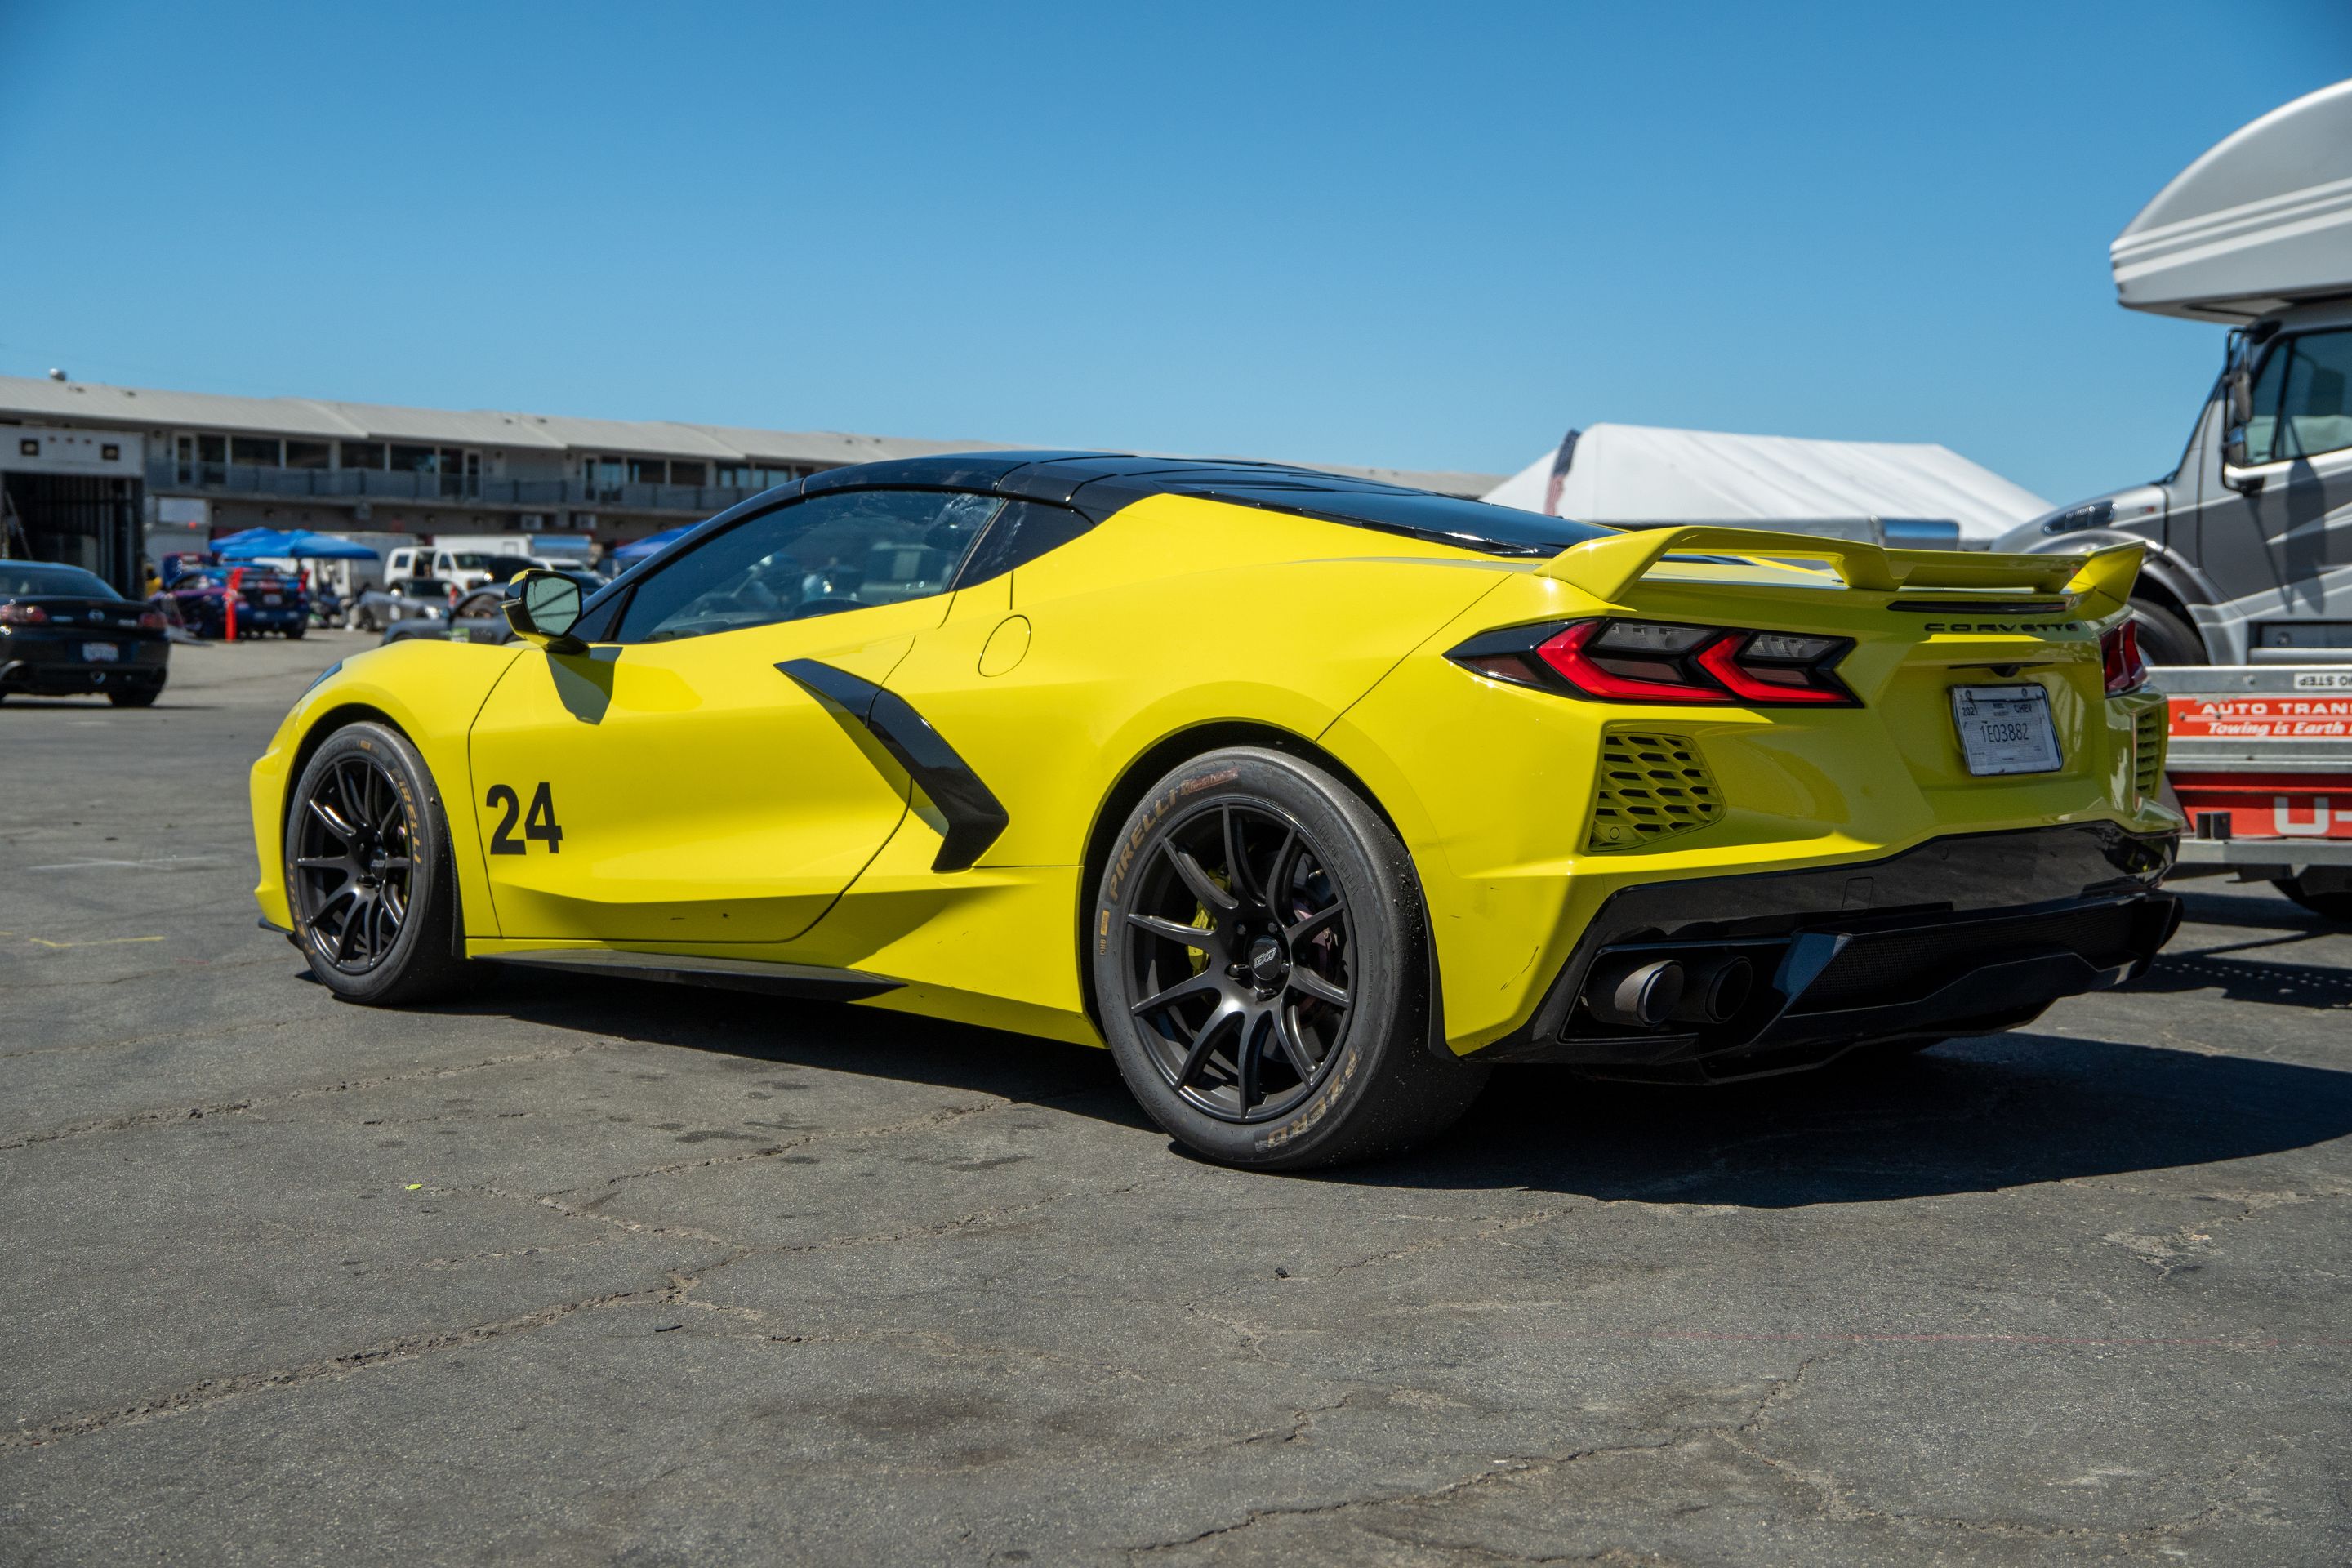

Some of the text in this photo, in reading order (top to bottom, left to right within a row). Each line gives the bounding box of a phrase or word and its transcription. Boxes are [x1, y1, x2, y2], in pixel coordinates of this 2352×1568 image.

[1924, 623, 2079, 632] CORVETTE
[2300, 676, 2334, 687] STEP
[2013, 703, 2033, 713] CHEV
[2201, 702, 2352, 715] AUTO TRAN
[1980, 723, 2029, 742] 1E03882
[2208, 721, 2270, 736] Towing
[2273, 721, 2289, 734] is
[2292, 721, 2345, 734] Earth
[486, 782, 564, 856] 24
[1109, 787, 1177, 902] PIRELLI
